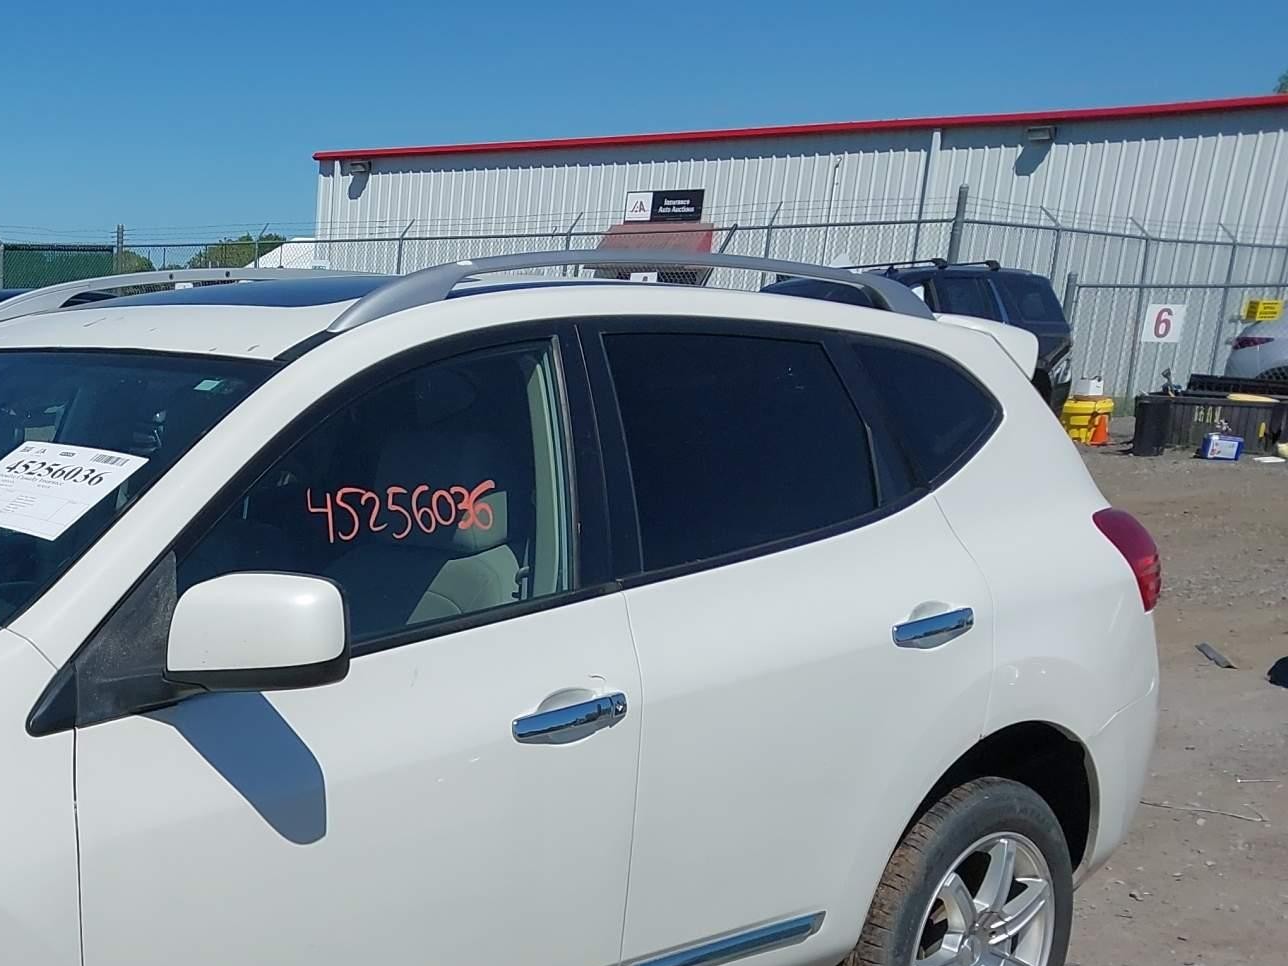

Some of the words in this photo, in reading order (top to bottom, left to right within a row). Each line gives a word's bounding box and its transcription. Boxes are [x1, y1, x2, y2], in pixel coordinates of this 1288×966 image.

[1153, 307, 1174, 339] 6
[5, 458, 112, 487] 45256036
[306, 479, 496, 544] 45256036
